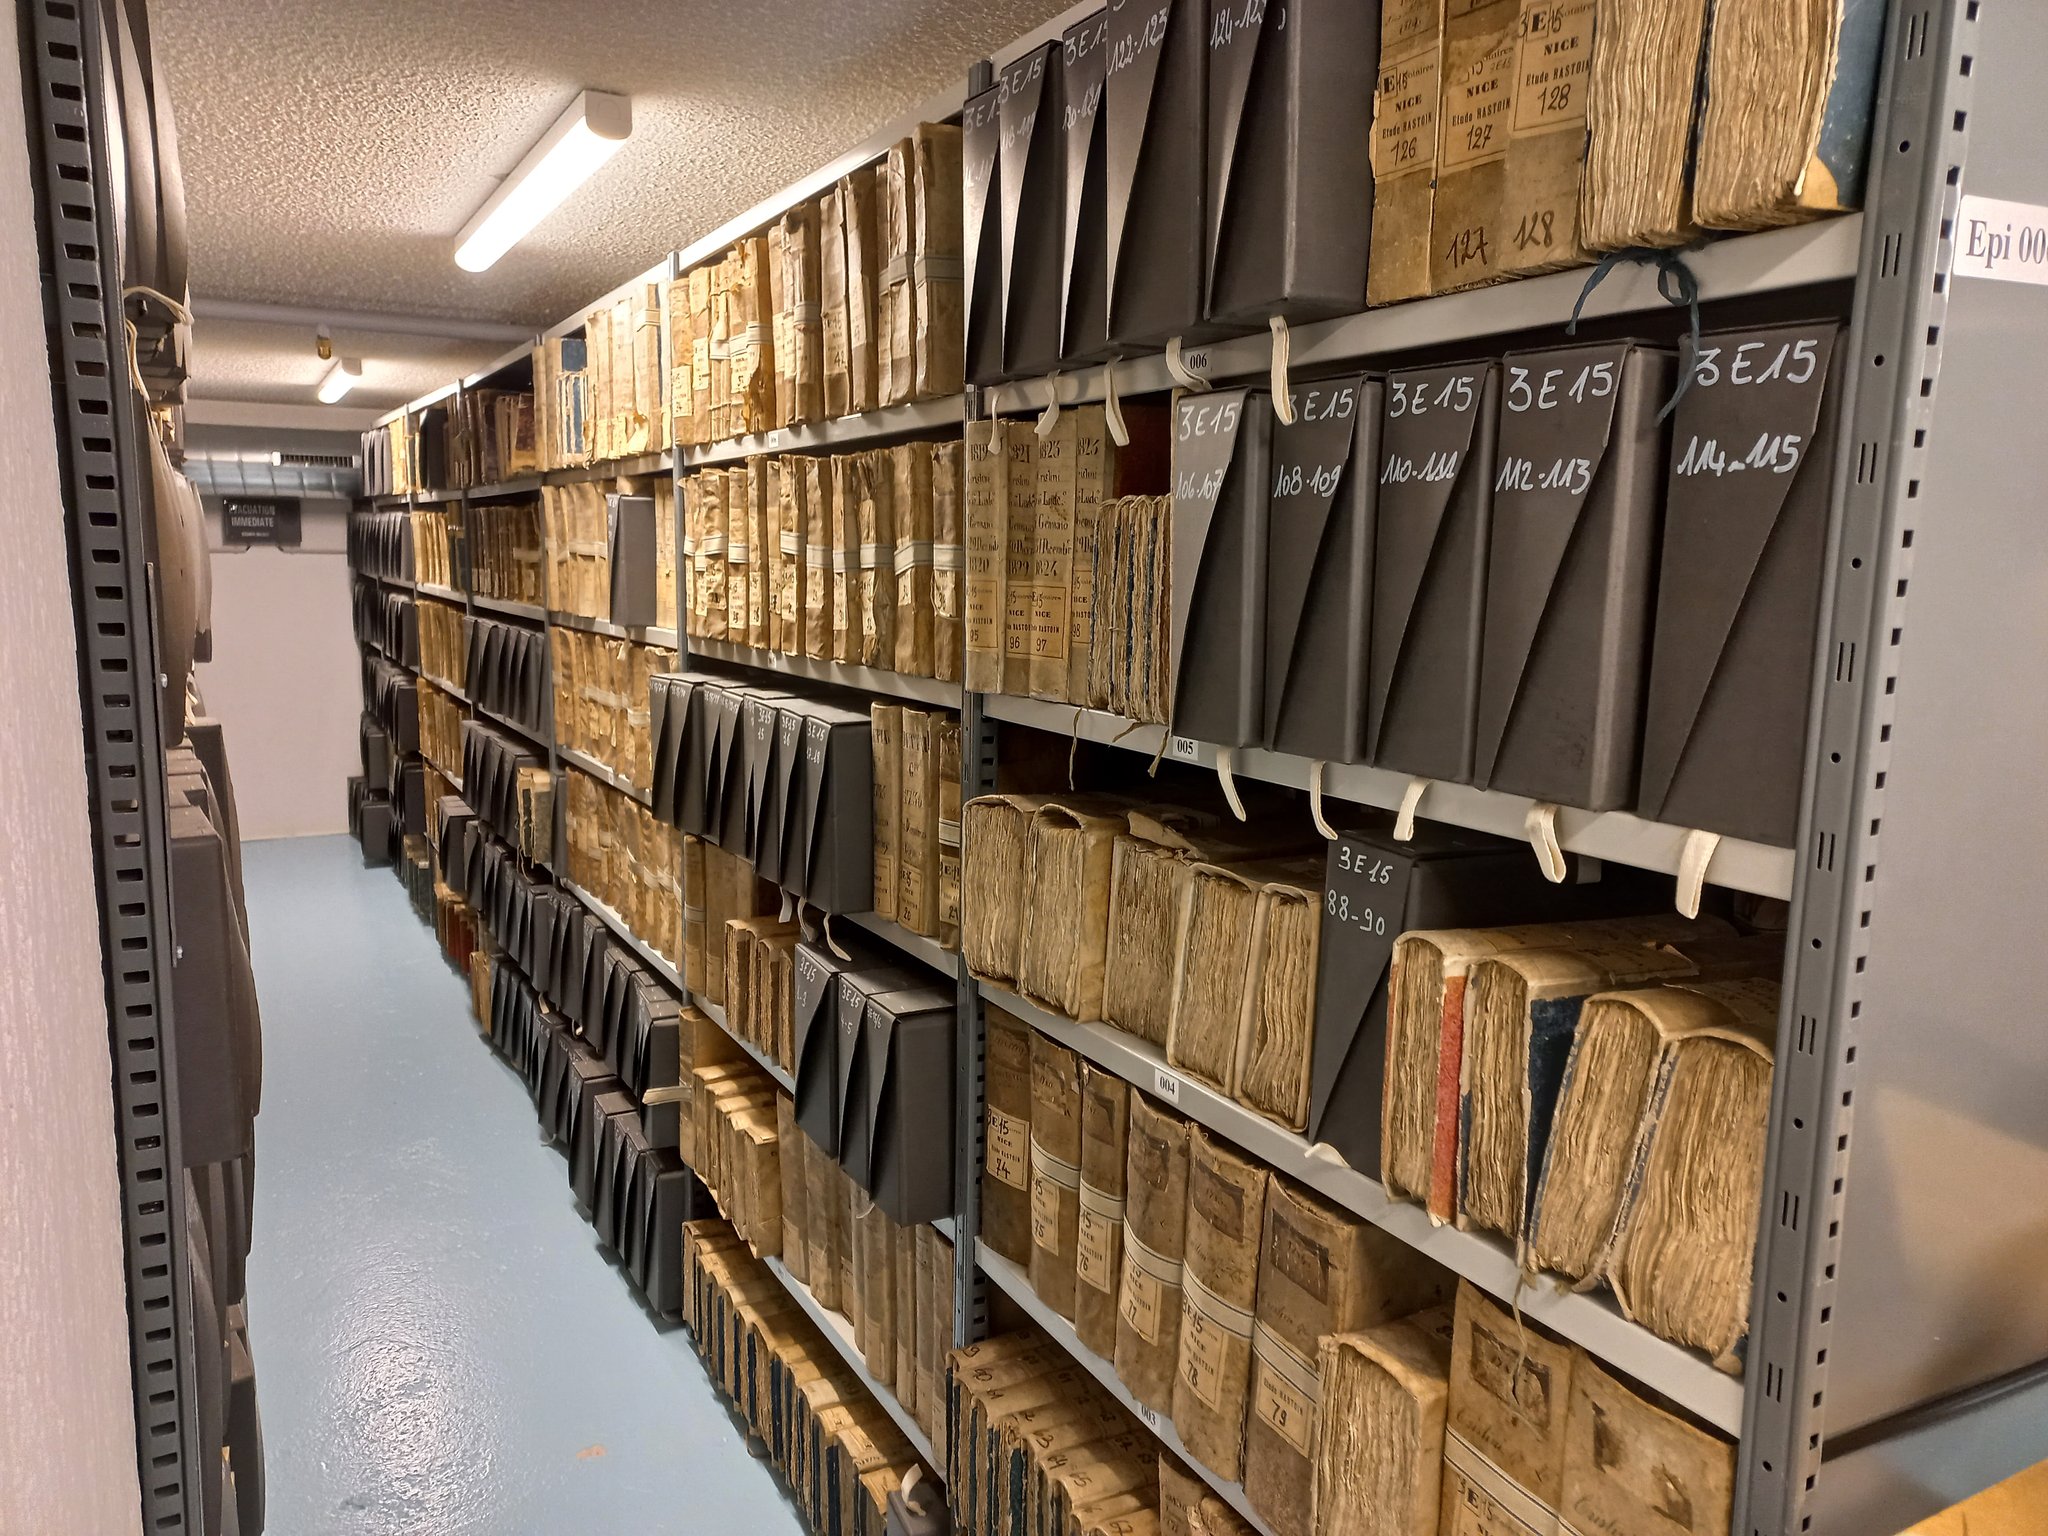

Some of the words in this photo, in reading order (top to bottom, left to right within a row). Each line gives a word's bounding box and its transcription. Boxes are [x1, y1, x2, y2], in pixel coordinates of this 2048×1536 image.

[1544, 35, 1578, 55] NICE
[1467, 78, 1499, 99] NICE
[1525, 71, 1549, 87] Etude
[1395, 94, 1422, 112] NICE
[1538, 83, 1571, 116] 128
[1452, 111, 1473, 127] Etude
[1382, 124, 1401, 140] Etude
[1466, 124, 1493, 151] 127
[1391, 137, 1418, 166] 126
[1446, 226, 1489, 268] 127
[1966, 219, 2011, 269] Epi
[2018, 226, 2048, 264] 00
[1190, 353, 1208, 370] 006
[231, 517, 275, 528] IMMEDIATE
[1009, 635, 1020, 650] 96
[1036, 637, 1047, 652] 97
[1177, 739, 1194, 755] 005
[1160, 1075, 1175, 1096] 004
[1079, 1250, 1090, 1273] 76
[1141, 1403, 1157, 1427] 003
[1271, 1397, 1289, 1428] 79
